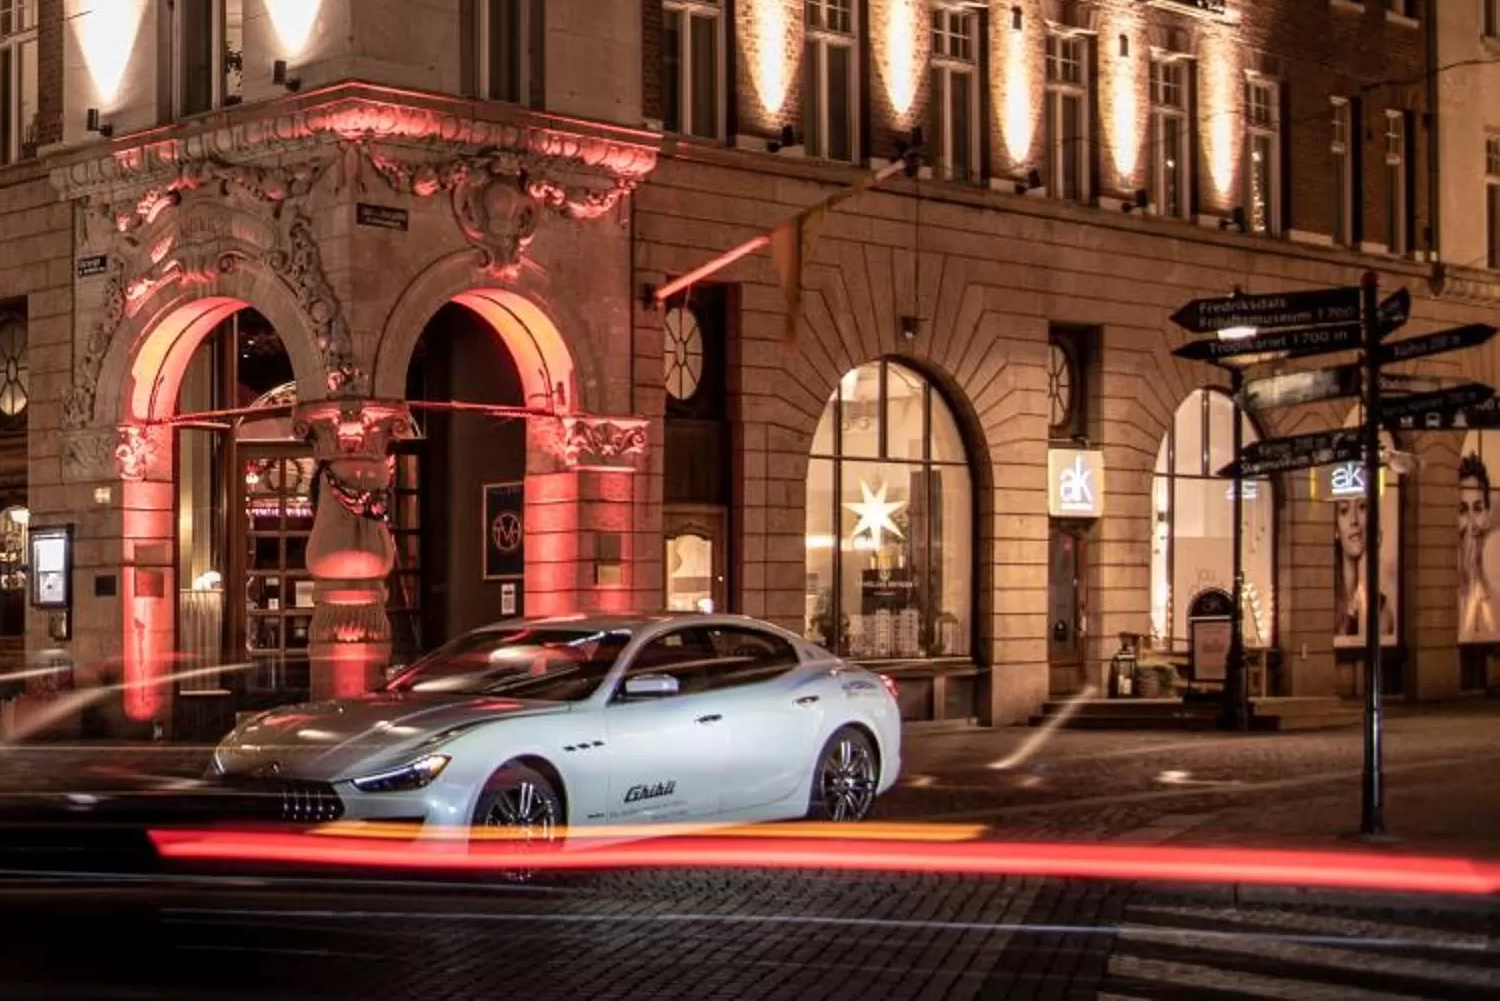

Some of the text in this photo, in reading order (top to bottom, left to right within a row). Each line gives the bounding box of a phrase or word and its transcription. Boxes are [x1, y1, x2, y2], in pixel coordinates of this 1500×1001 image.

[1060, 454, 1094, 502] ak
[1331, 462, 1365, 489] ak
[623, 780, 677, 804] Ghibli
